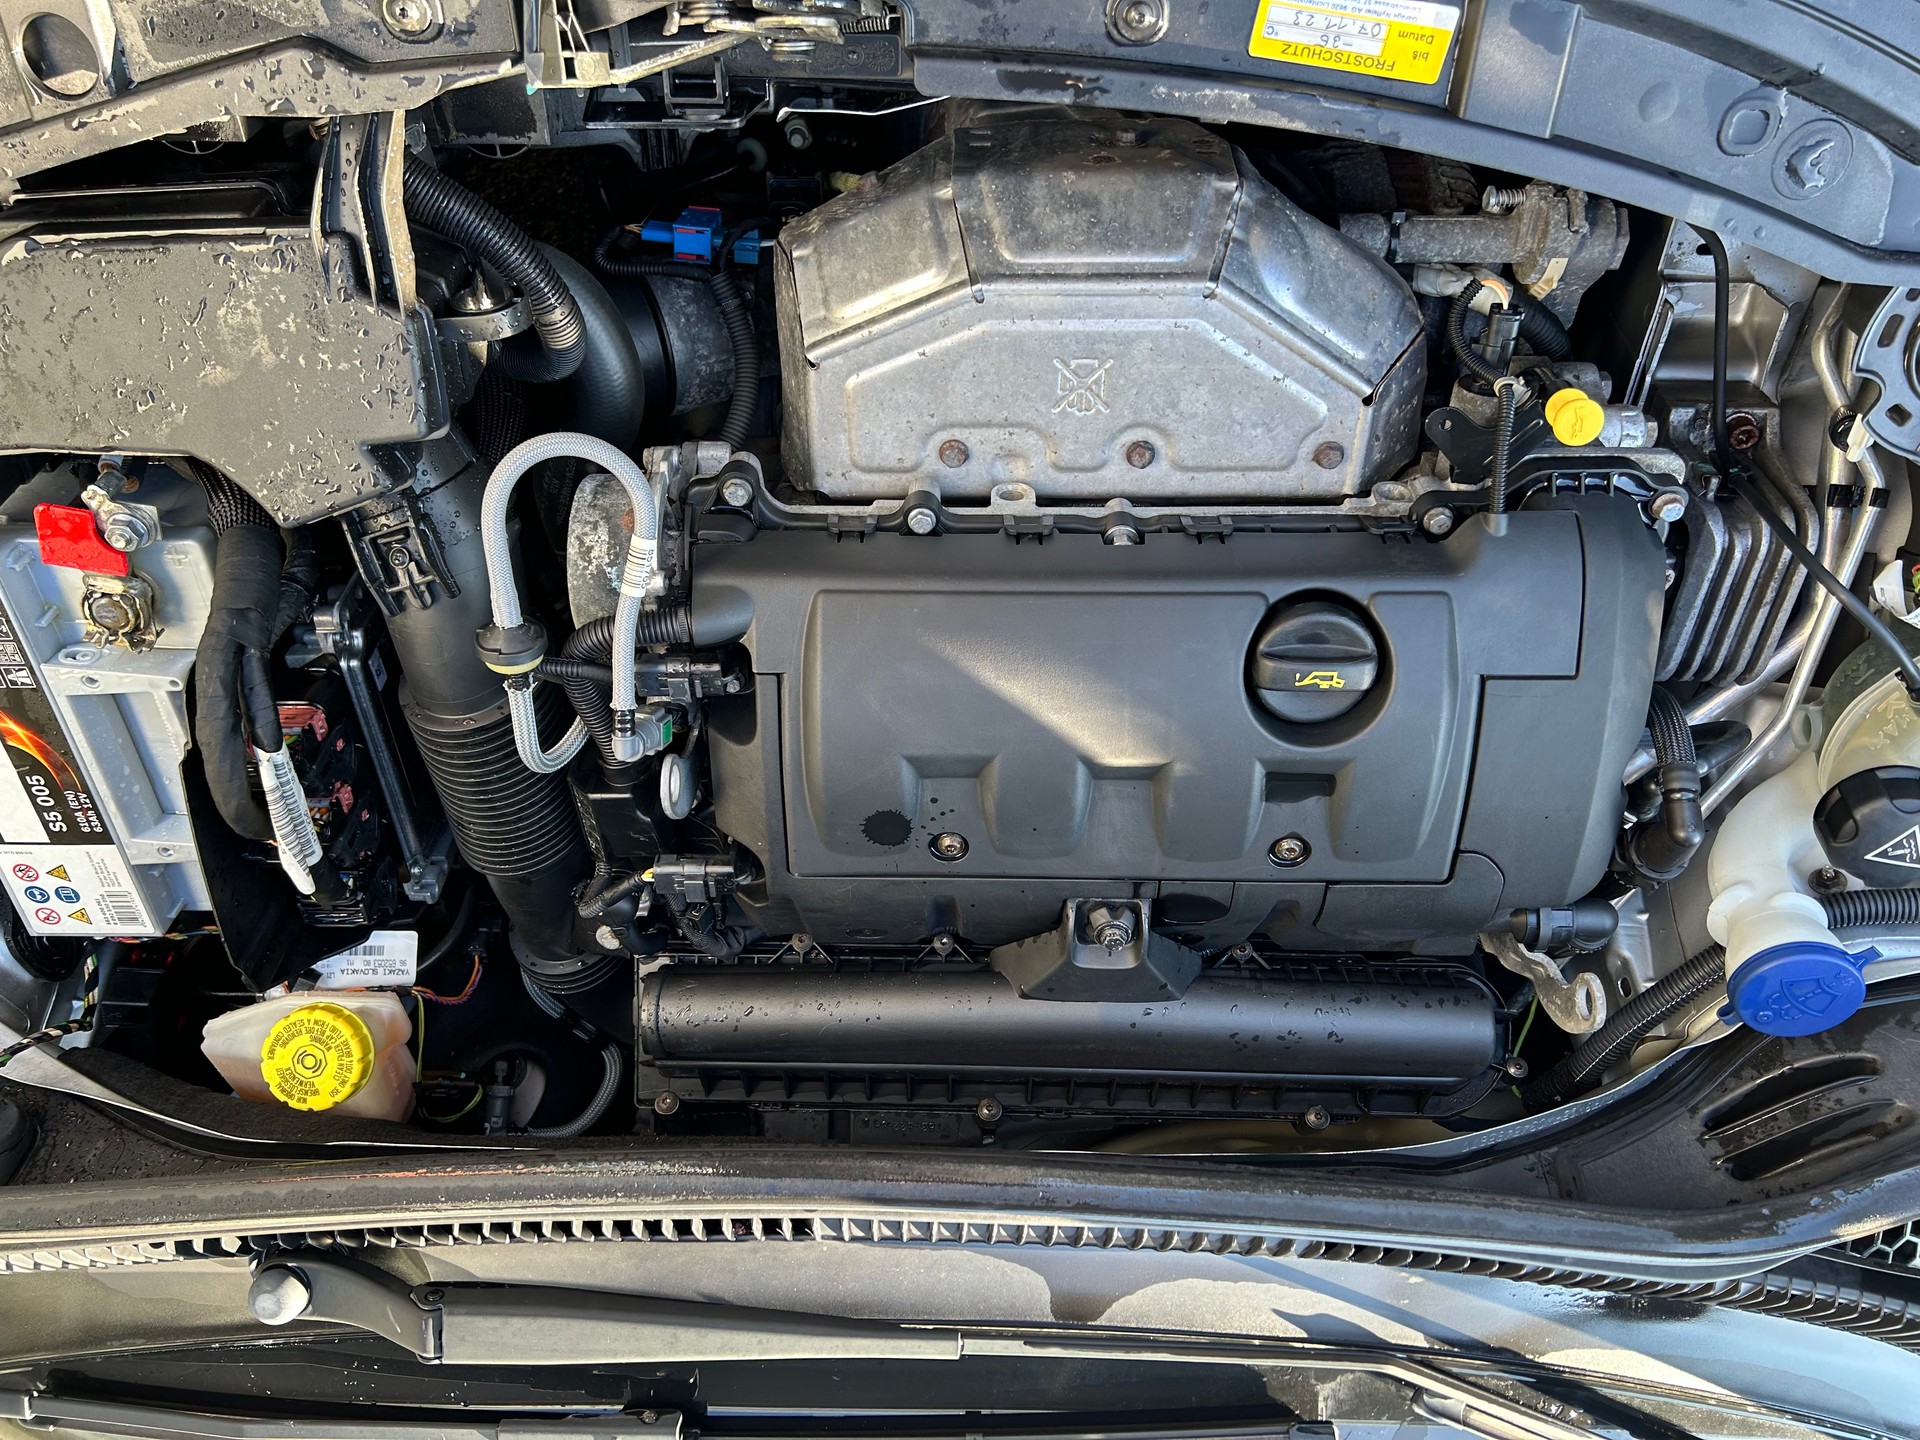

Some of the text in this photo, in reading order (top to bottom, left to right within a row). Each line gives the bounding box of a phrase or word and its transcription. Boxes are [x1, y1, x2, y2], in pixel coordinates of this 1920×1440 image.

[1351, 6, 1363, 14] AG
[1393, 13, 1418, 21] Garage
[1397, 30, 1435, 45] Datum
[1280, 42, 1395, 71] FROSTSCHUTZ
[1412, 50, 1430, 62] bis
[25, 775, 68, 833] S5 005
[64, 790, 91, 833] 610A (EN)
[77, 792, 103, 833] 63Ah 12V
[340, 968, 410, 976] YAZAKI SLOVAKIA
[283, 1019, 305, 1034] SEALED
[313, 1018, 330, 1029] FROM
[329, 1025, 345, 1040] FLUID
[267, 1031, 285, 1061] CONTAINER
[310, 1034, 333, 1053] WARNING
[342, 1037, 354, 1058] BRAKE
[280, 1026, 345, 1081] CLEAN FILLER CAP BEFORE REMOVING
[284, 1066, 316, 1089] VERWENDEN
[339, 1075, 351, 1089] ONLY
[275, 1081, 296, 1101] ORIGINAL
[328, 1086, 342, 1098] USE
